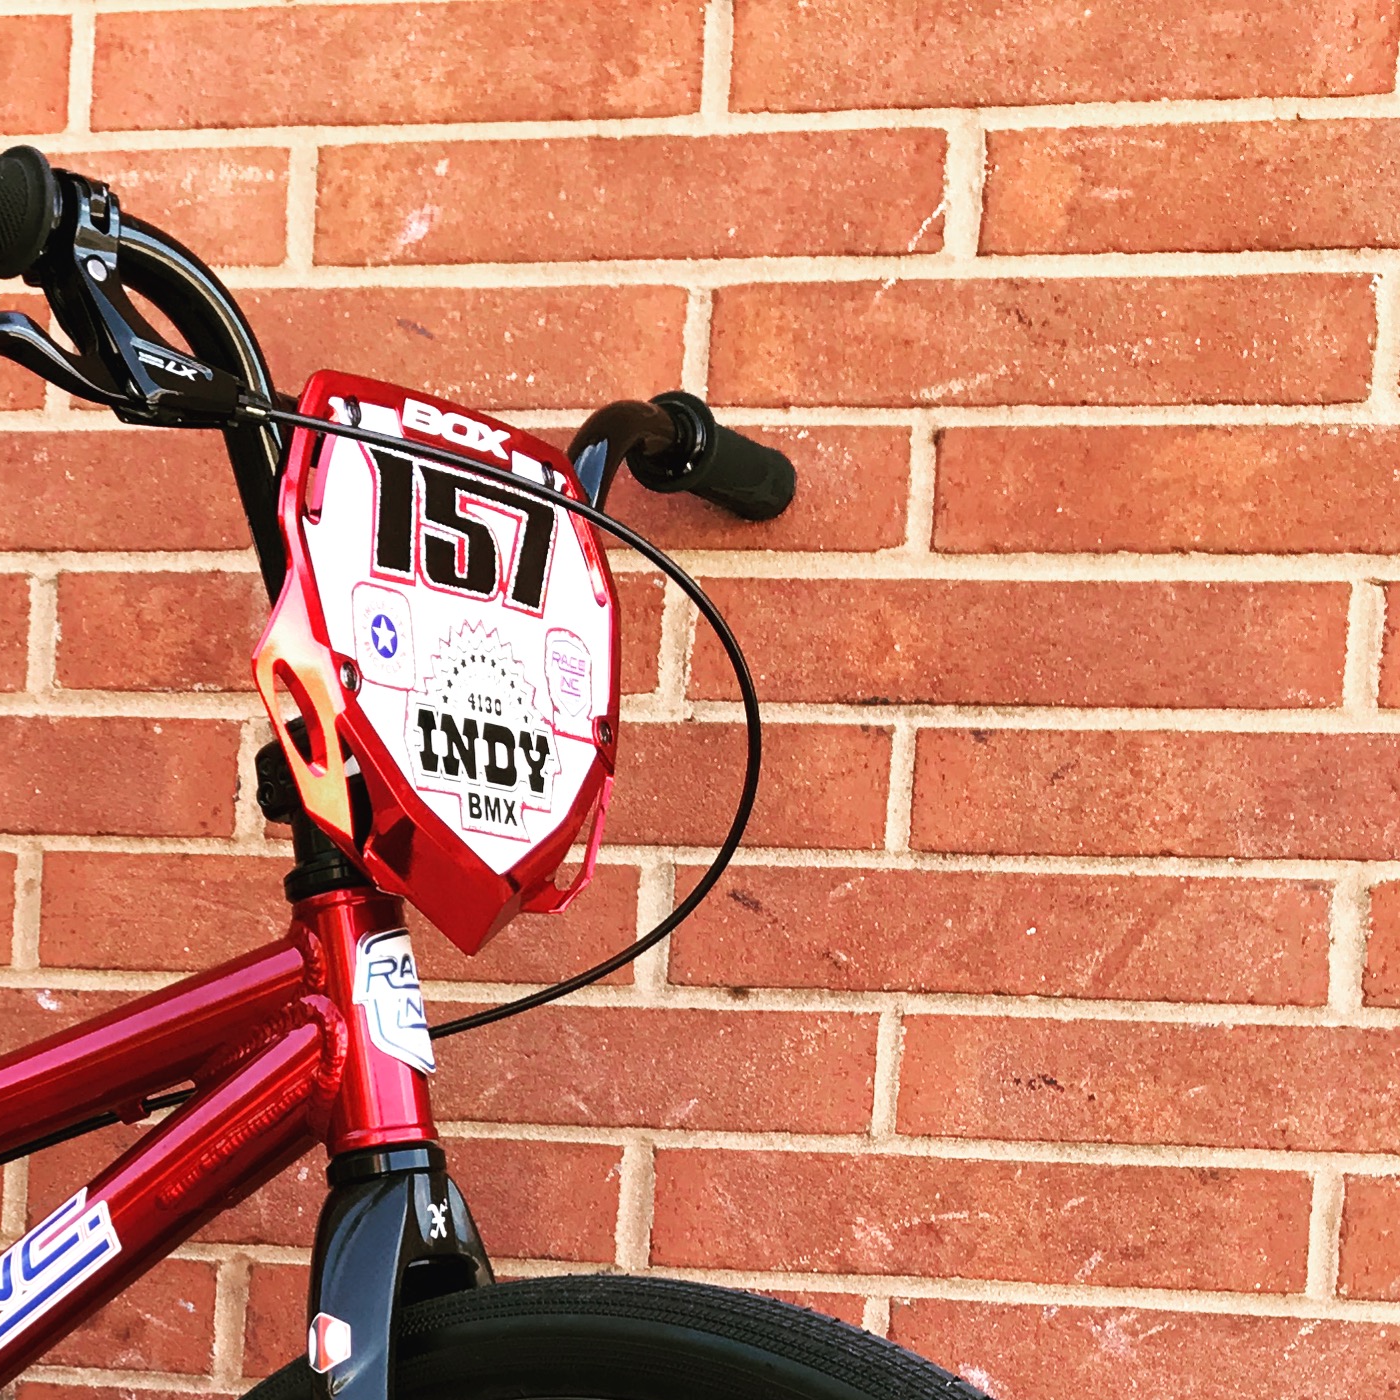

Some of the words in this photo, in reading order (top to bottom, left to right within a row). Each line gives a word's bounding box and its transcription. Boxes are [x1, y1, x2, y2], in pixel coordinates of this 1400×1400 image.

[402, 398, 510, 460] BOX
[368, 445, 555, 612] 157
[467, 693, 502, 716] 4130
[418, 709, 551, 793] INDY
[468, 792, 518, 827] BMX
